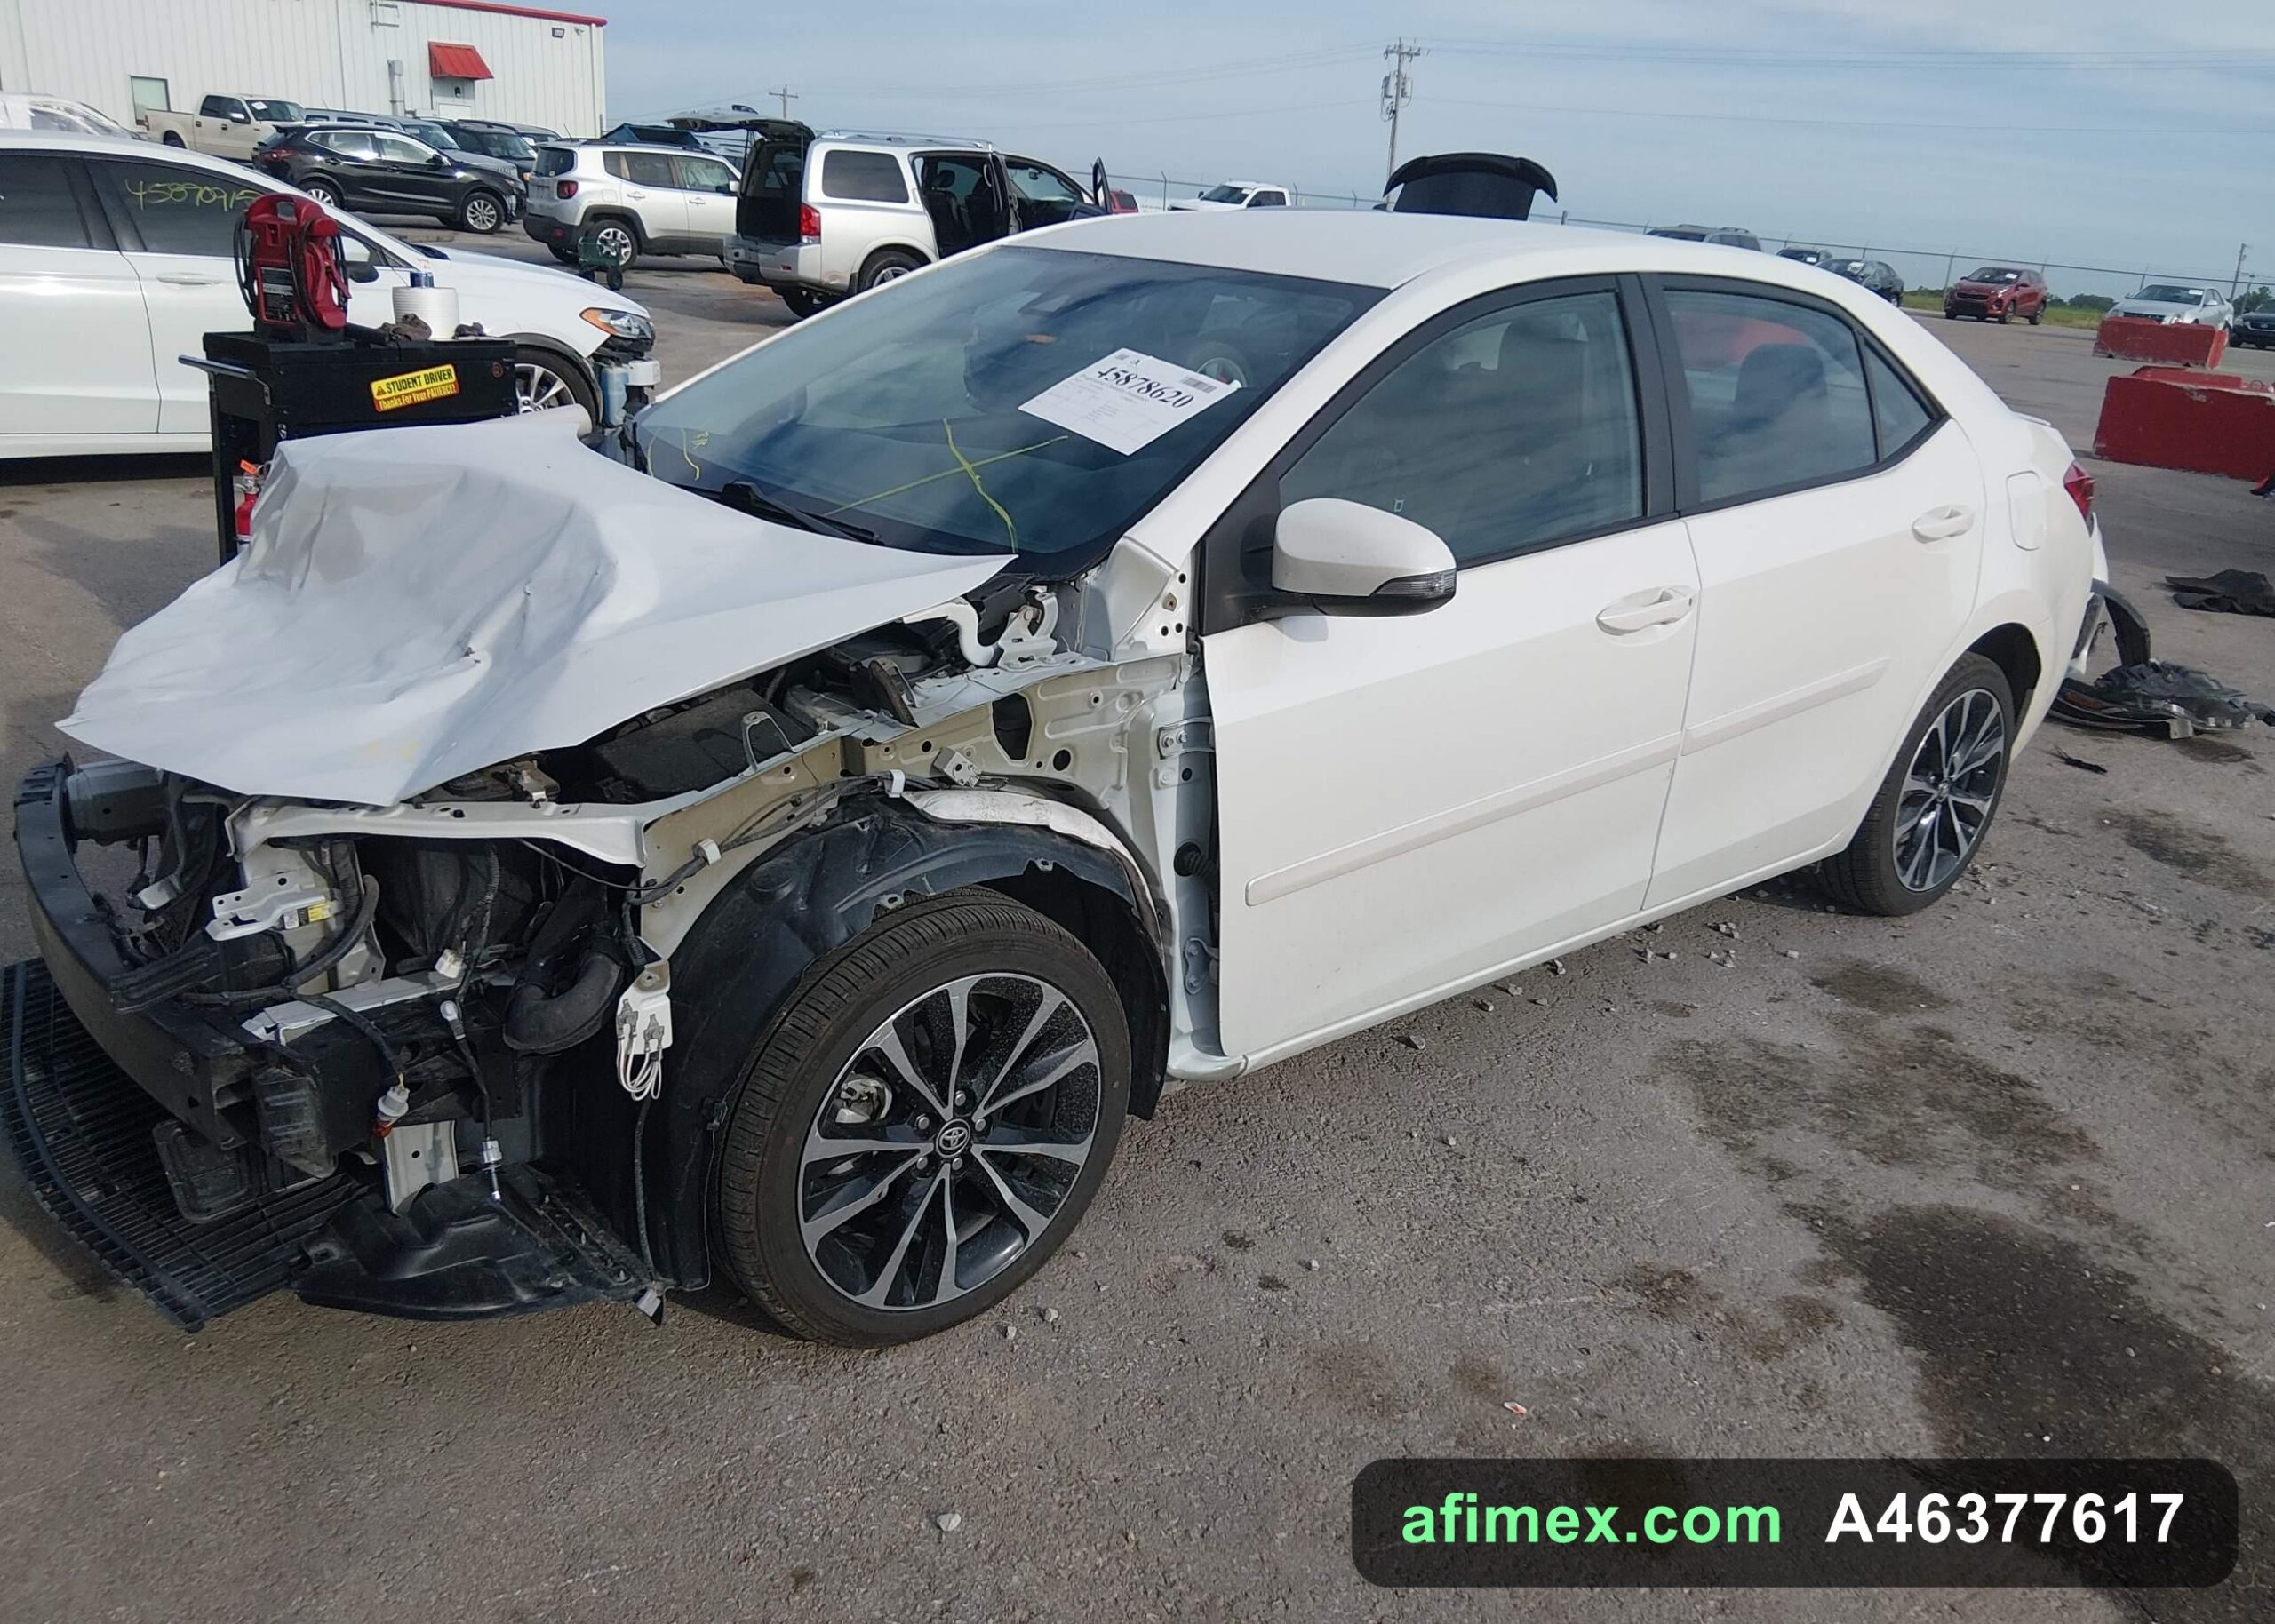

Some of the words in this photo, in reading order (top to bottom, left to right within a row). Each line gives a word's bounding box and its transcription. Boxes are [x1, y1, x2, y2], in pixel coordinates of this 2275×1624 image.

[386, 375, 422, 394] STUDENT
[424, 369, 453, 385] DRIVER
[1098, 366, 1194, 408] 45878620
[379, 395, 402, 410] Thanks
